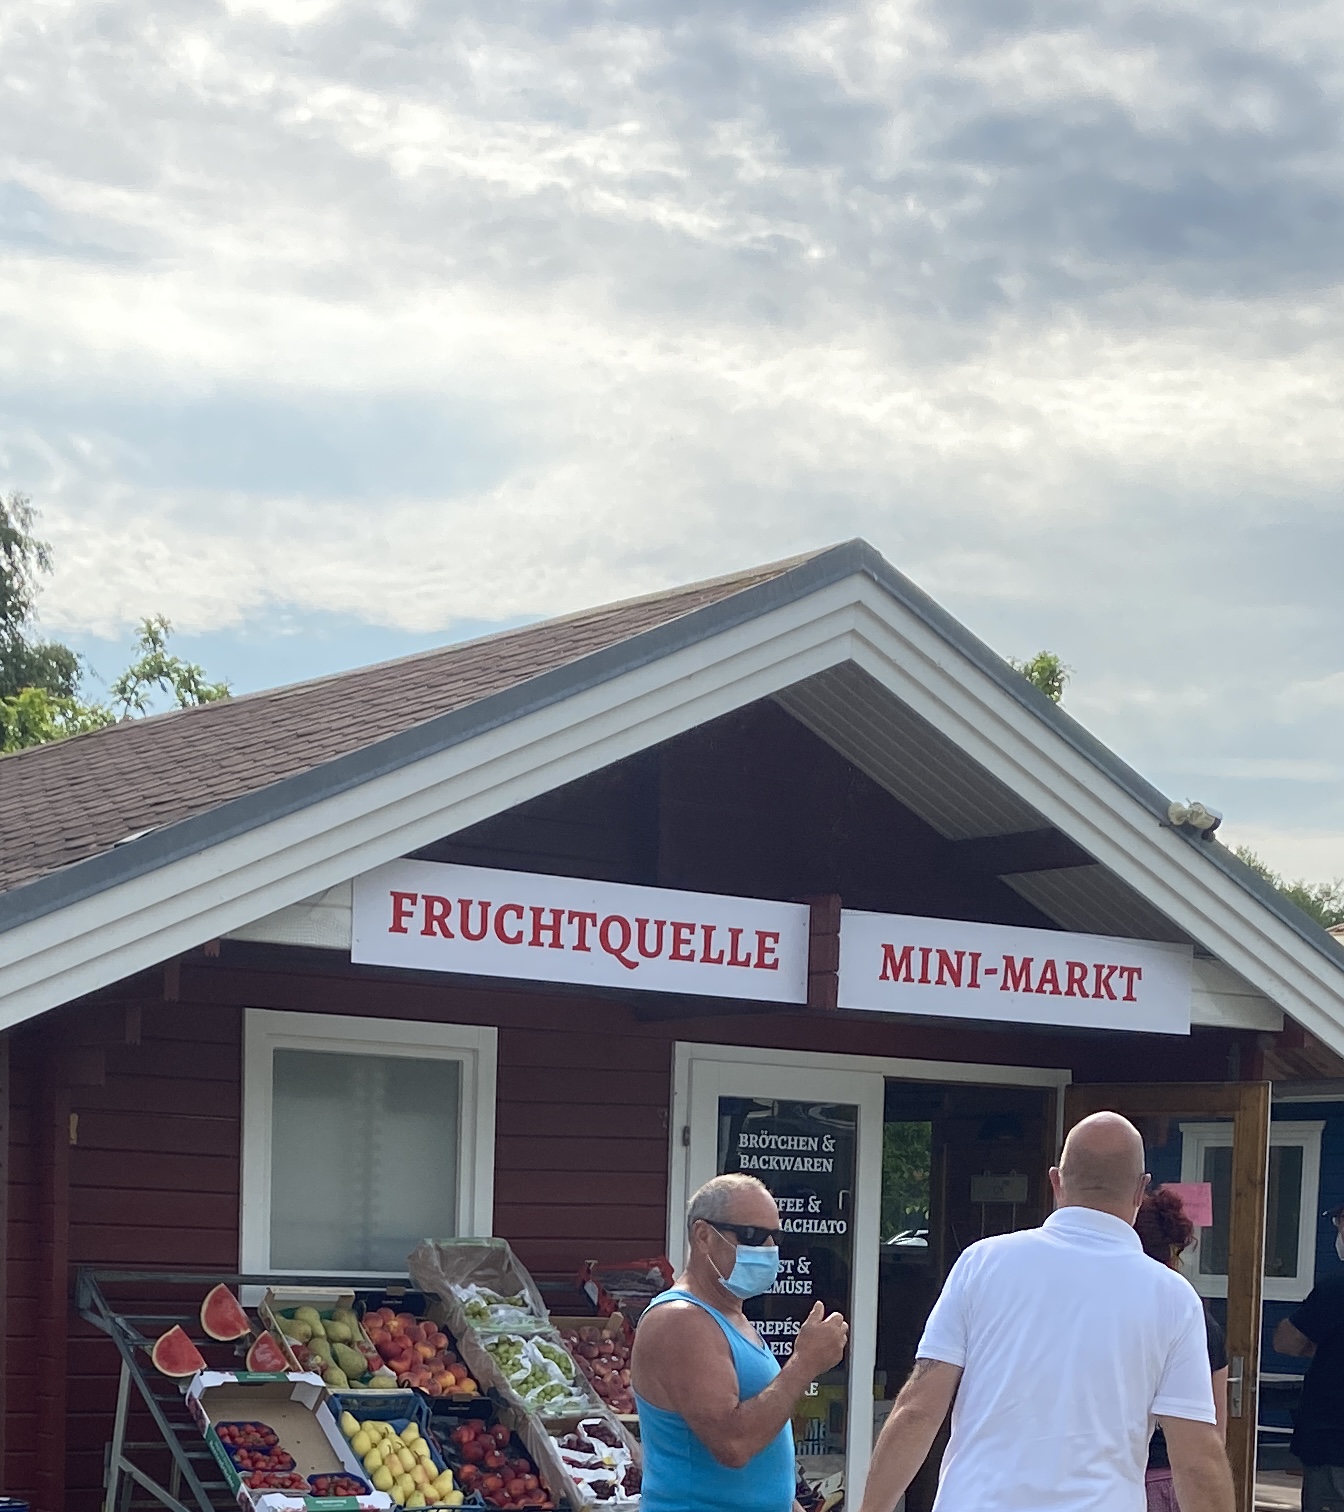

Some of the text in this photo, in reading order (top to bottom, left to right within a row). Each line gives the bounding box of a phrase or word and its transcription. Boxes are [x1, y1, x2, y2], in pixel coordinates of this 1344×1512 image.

[388, 889, 782, 971] FRUCHTQUELLE
[878, 943, 1143, 1003] MINI-MARKT
[738, 1130, 836, 1152] BRÖTCHEN &
[739, 1154, 834, 1173] BACKWAREN
[774, 1195, 822, 1213] FEE &
[777, 1256, 812, 1275] ST &
[764, 1276, 813, 1295] MÜSE
[769, 1341, 793, 1356] EIS
